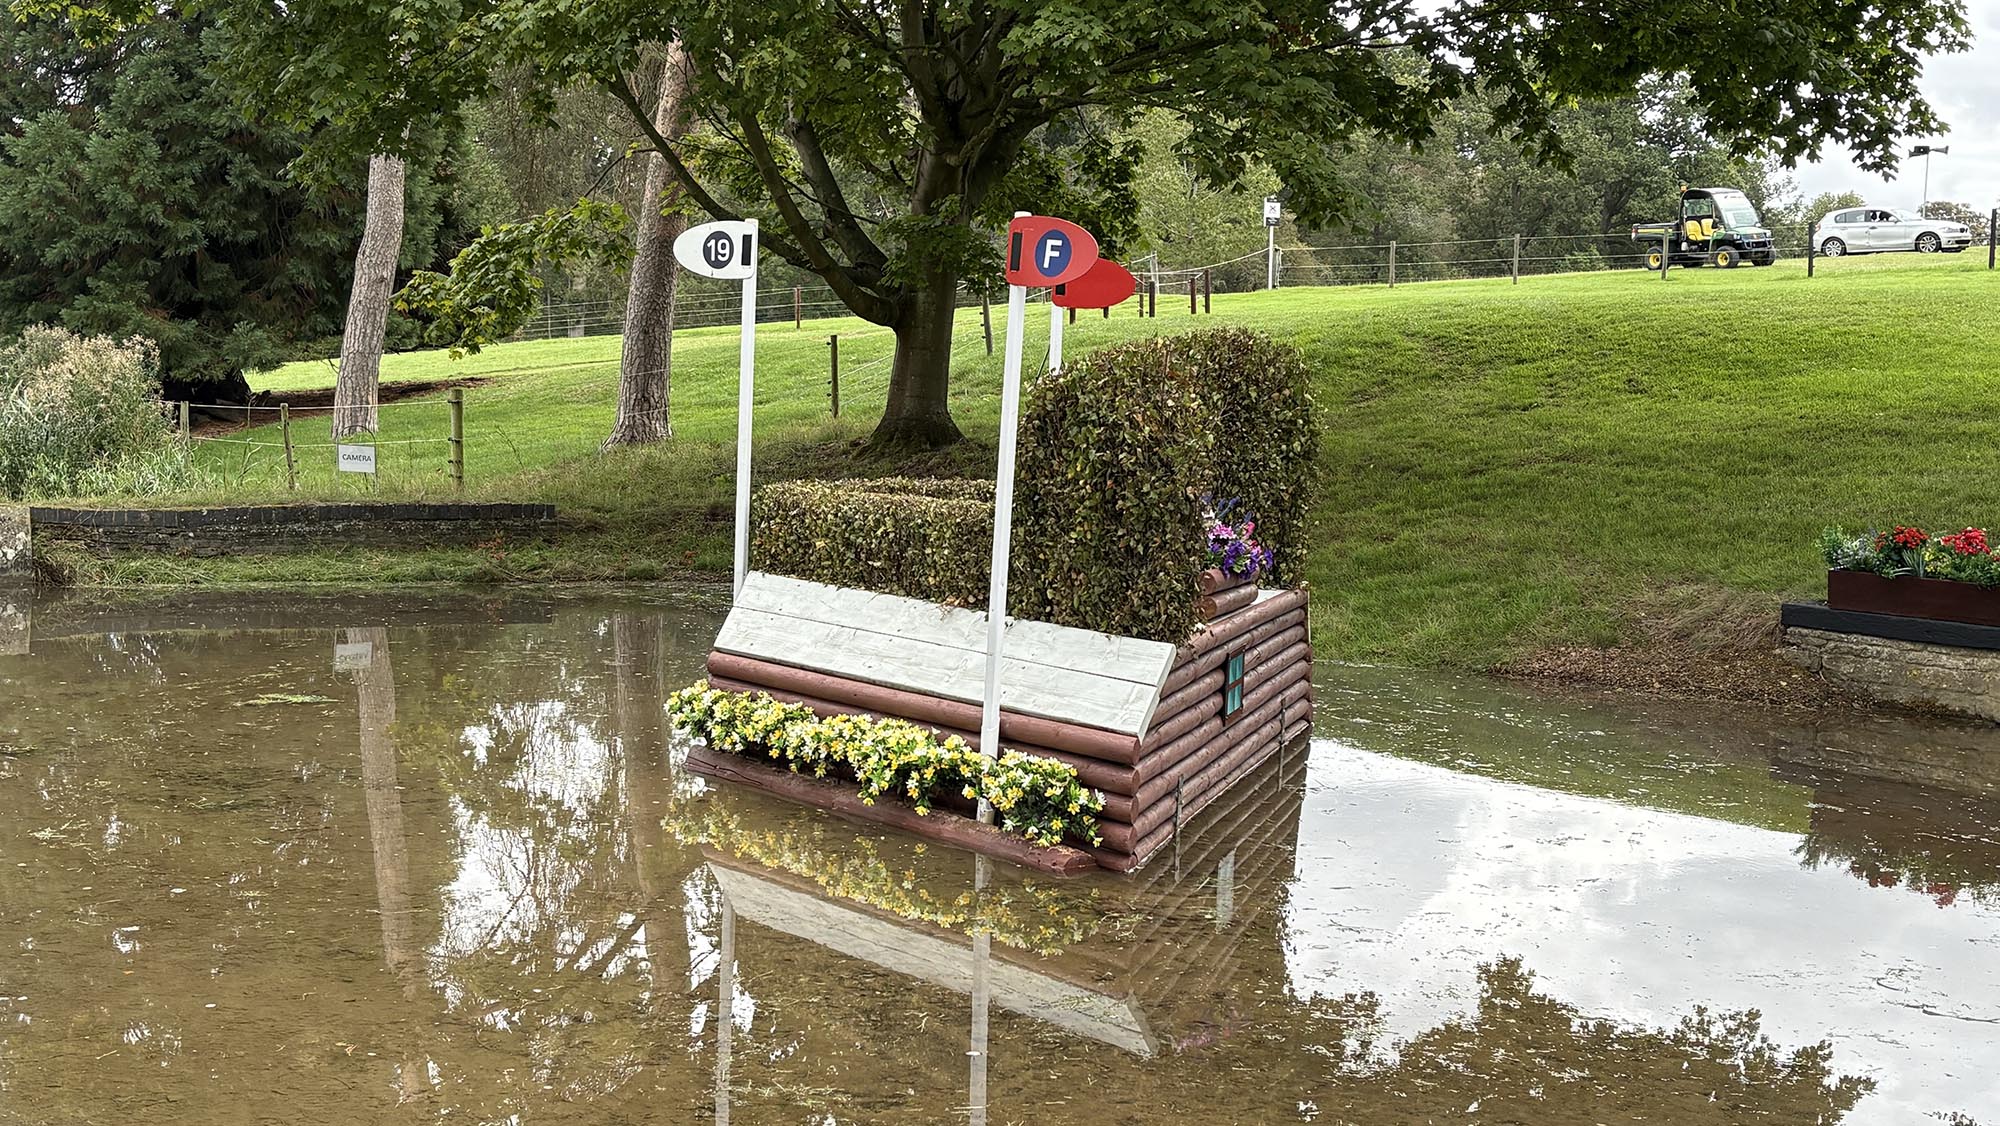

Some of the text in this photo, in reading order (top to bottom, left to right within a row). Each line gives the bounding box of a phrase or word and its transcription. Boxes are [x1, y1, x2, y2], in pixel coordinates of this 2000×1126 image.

[706, 238, 730, 262] 19
[1043, 239, 1063, 269] F
[341, 453, 372, 462] CAMERA
